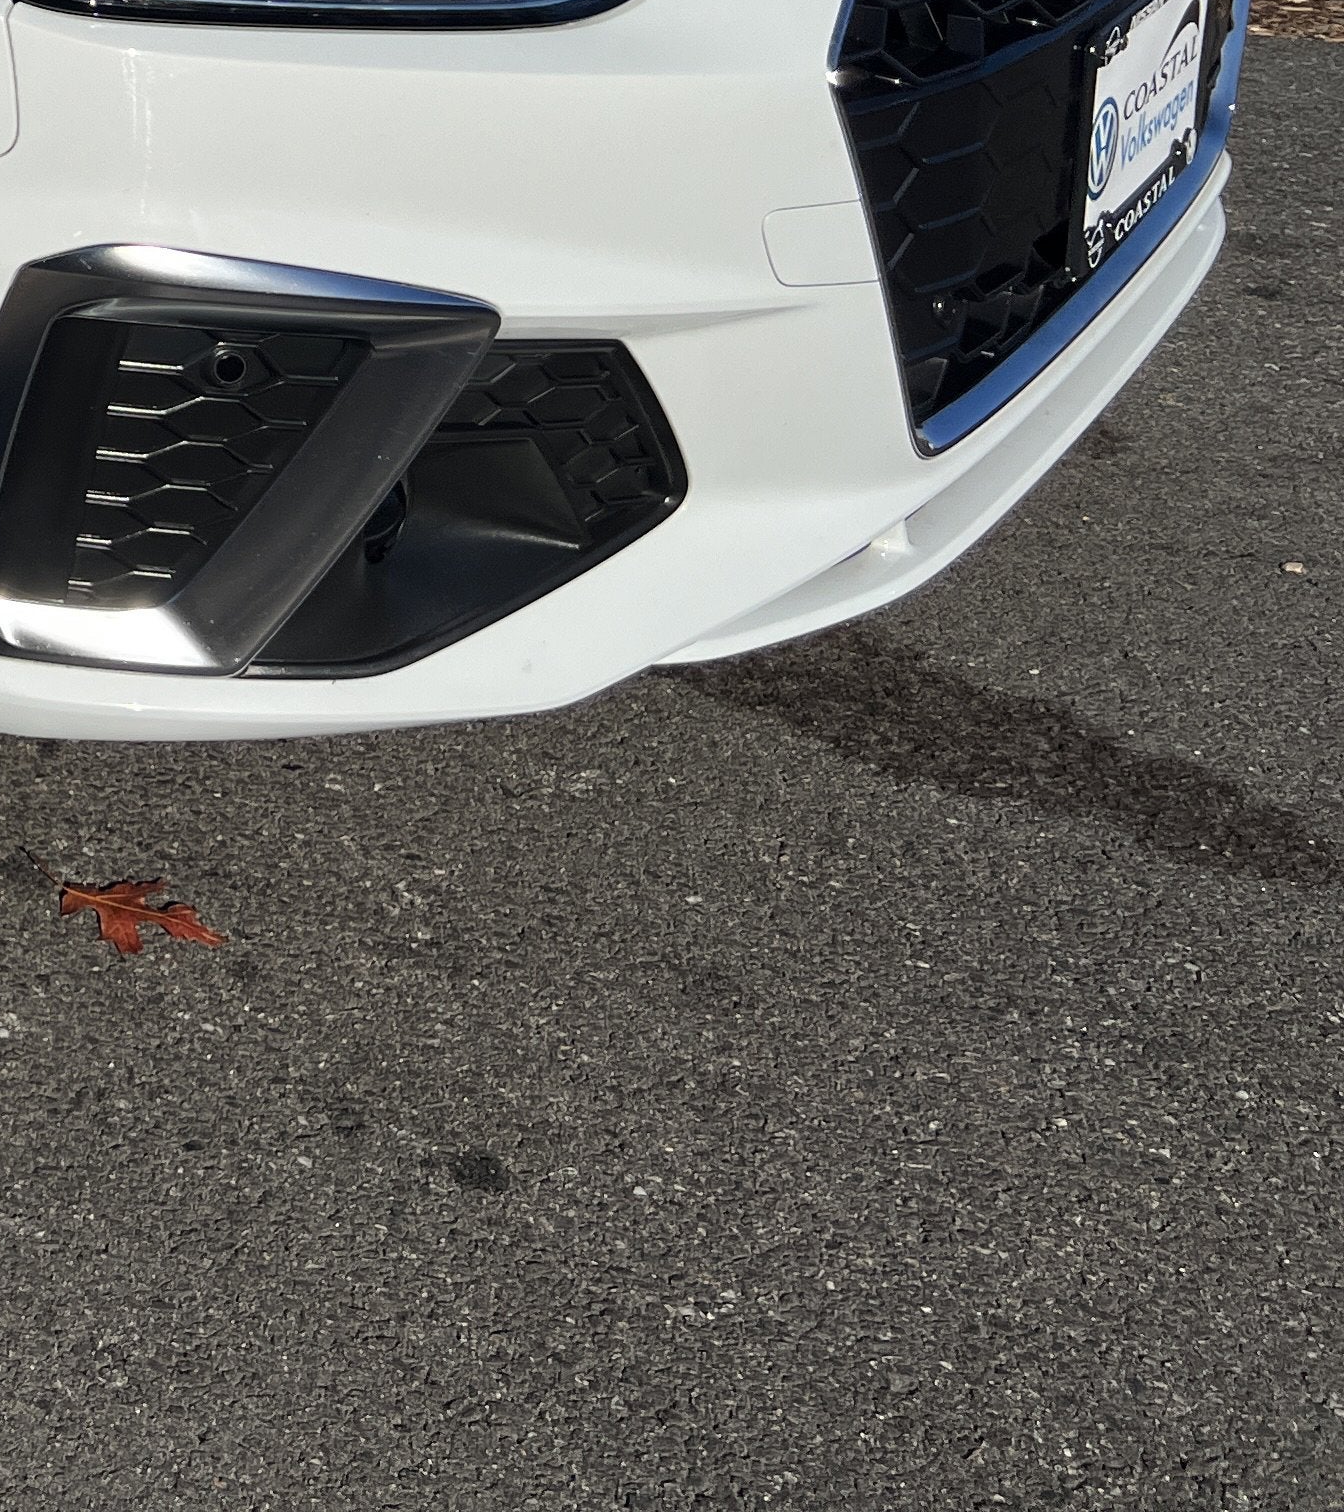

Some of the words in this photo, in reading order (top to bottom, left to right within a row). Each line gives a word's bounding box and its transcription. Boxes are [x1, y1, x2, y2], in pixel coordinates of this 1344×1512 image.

[1123, 35, 1198, 120] COASTAL
[1121, 80, 1194, 170] Volkswagen
[1114, 166, 1176, 241] COASTAL
